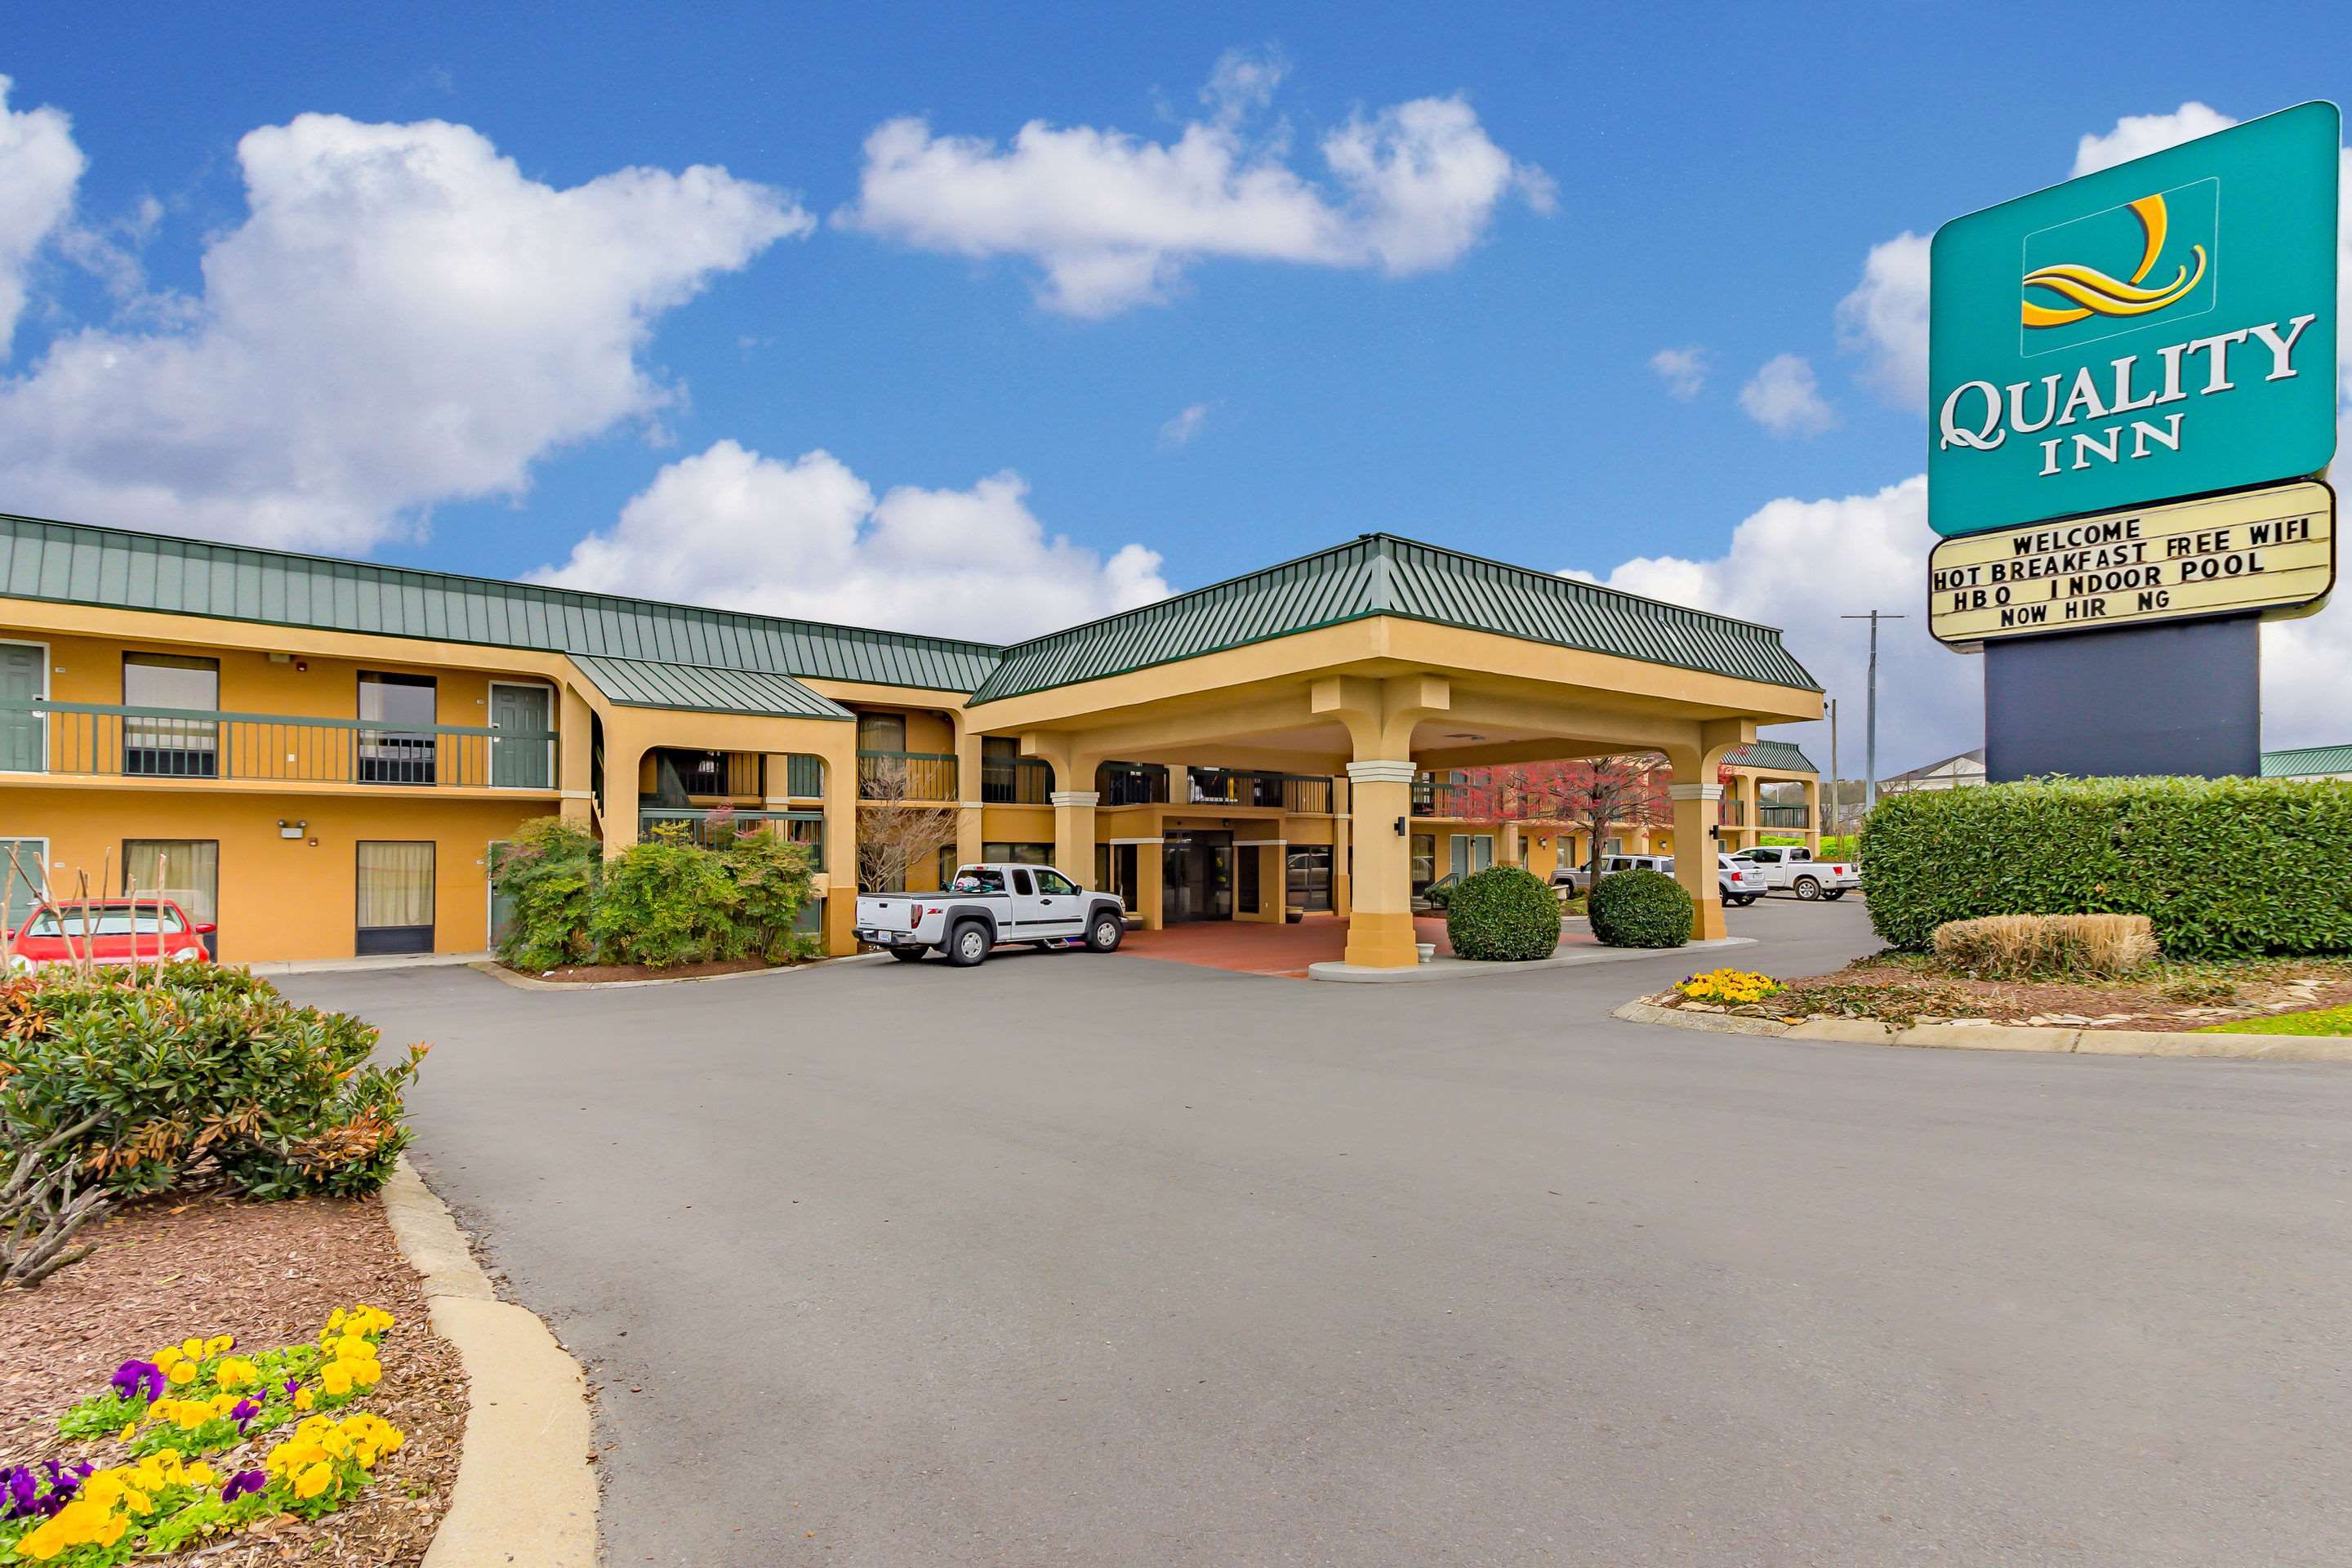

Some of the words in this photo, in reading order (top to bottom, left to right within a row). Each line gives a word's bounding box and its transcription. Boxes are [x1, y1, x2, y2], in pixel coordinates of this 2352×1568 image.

[1940, 314, 2315, 451] QUALITY
[2039, 413, 2185, 476] INN
[1934, 567, 1980, 590] HOT
[1991, 542, 2146, 582] BREAKFAST
[2167, 530, 2230, 556] FREE
[2250, 518, 2308, 545] WIFI
[2013, 519, 2140, 555] WELCOME
[1954, 586, 2010, 610] HBO
[2051, 566, 2160, 598] INDOOR
[2181, 552, 2264, 581] POOL
[2001, 604, 2047, 627] NOW
